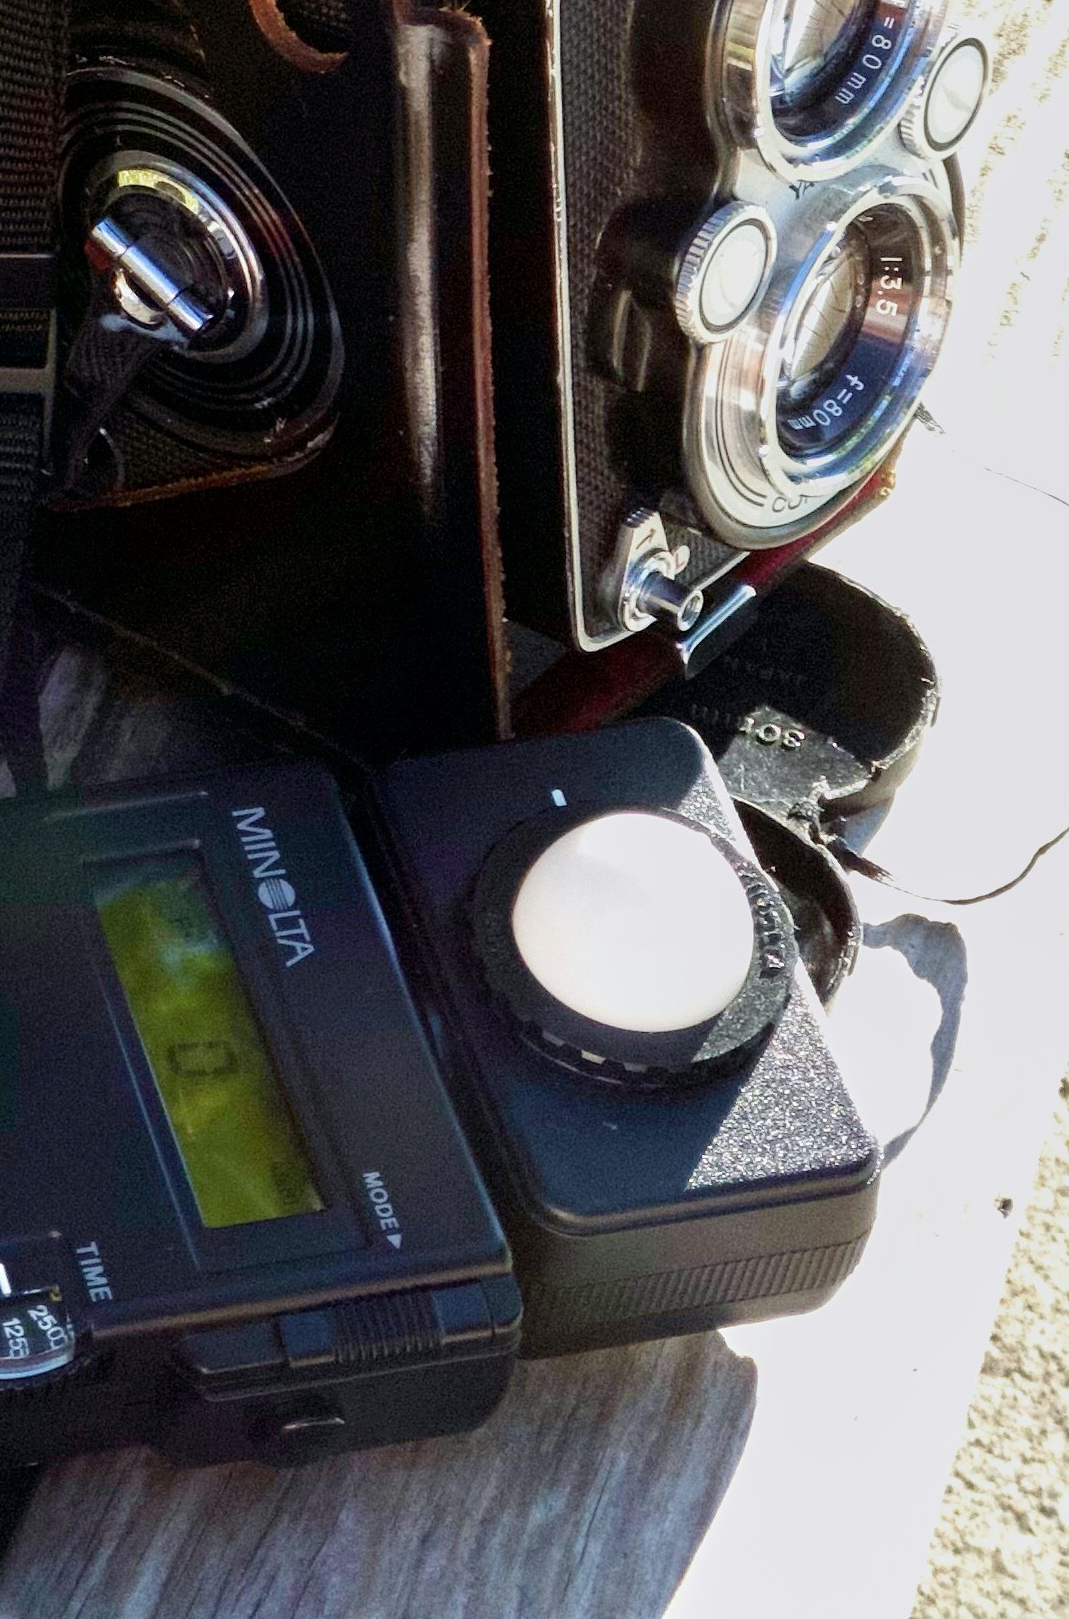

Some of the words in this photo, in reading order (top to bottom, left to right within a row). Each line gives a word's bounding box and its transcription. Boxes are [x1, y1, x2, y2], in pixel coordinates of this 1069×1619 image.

[232, 806, 315, 968] MINOLTA
[362, 1171, 400, 1230] MODE
[75, 1241, 112, 1302] TIME
